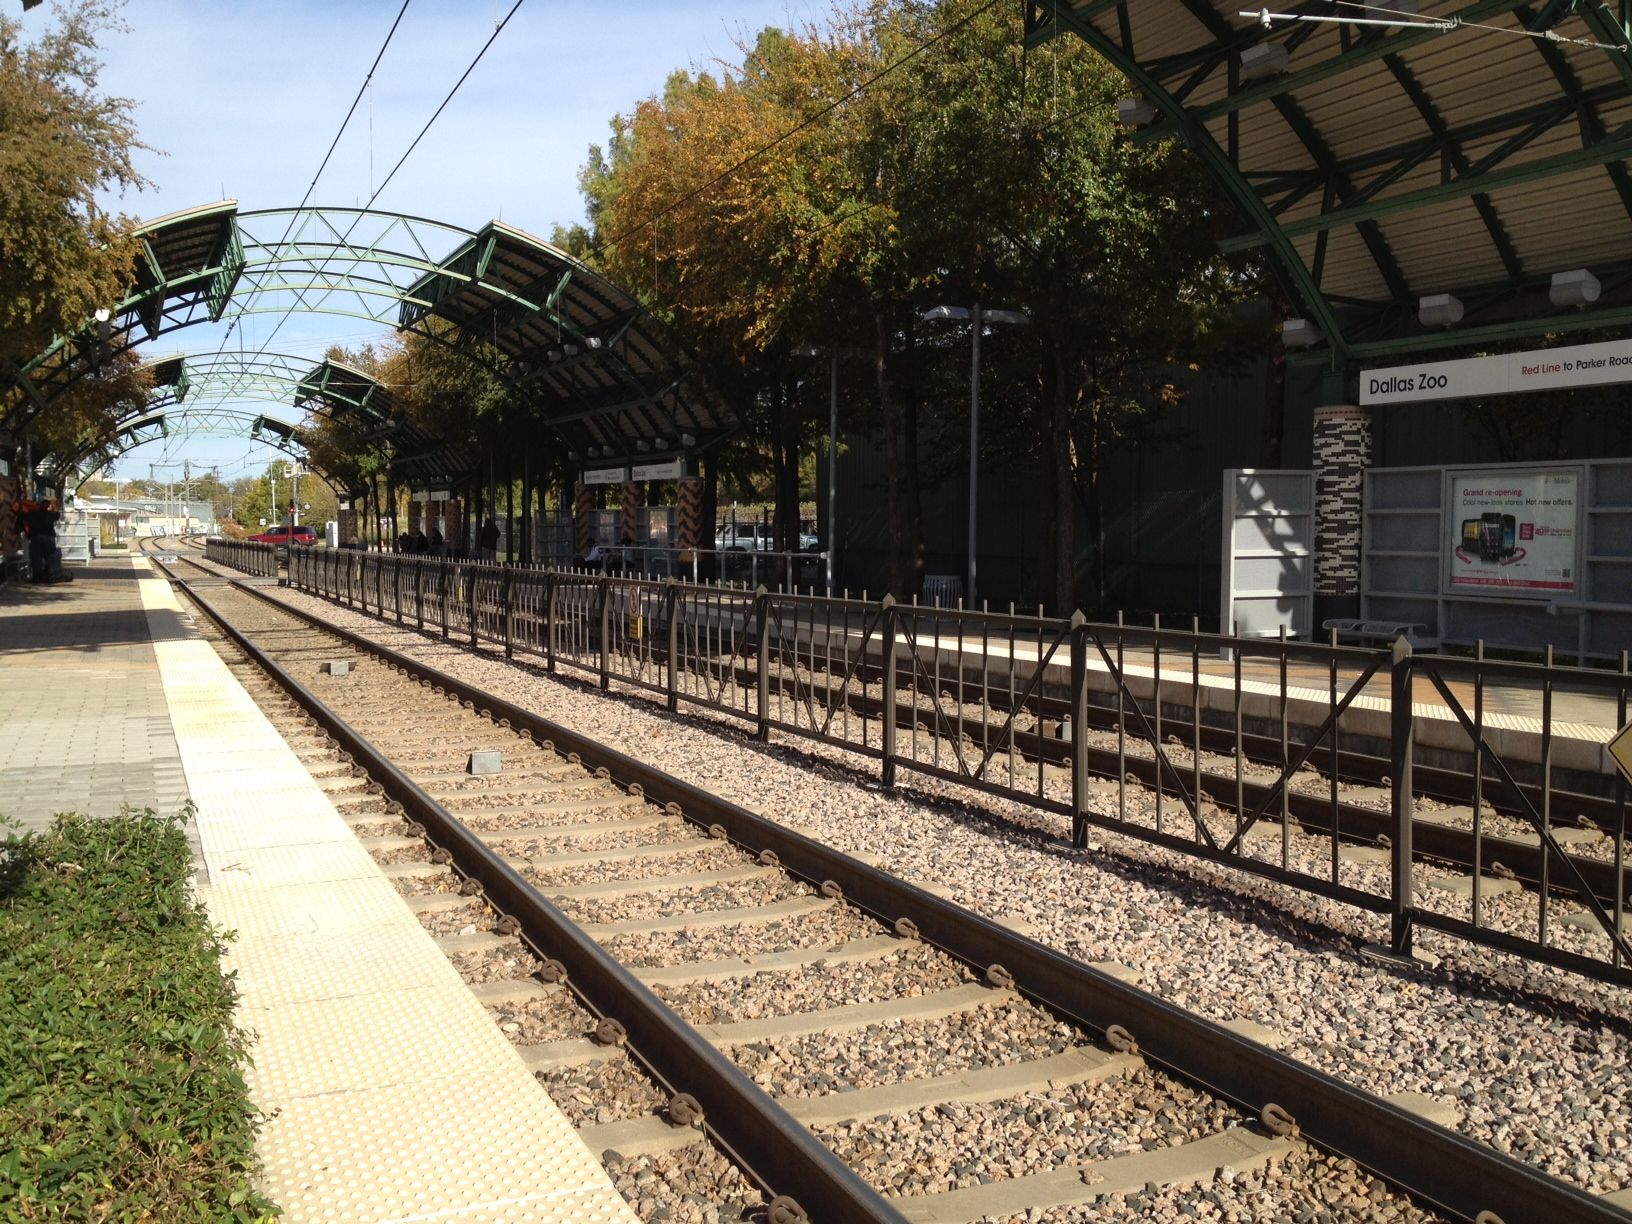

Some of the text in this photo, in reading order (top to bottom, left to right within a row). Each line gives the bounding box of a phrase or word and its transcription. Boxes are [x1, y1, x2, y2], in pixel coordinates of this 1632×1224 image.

[1521, 364, 1540, 375] Red
[1542, 363, 1561, 374] Line
[1563, 361, 1573, 371] to
[1576, 358, 1606, 370] Parker
[1370, 373, 1448, 395] Dallas Zoo
[1463, 488, 1484, 497] Grand
[1525, 498, 1537, 506] Hot
